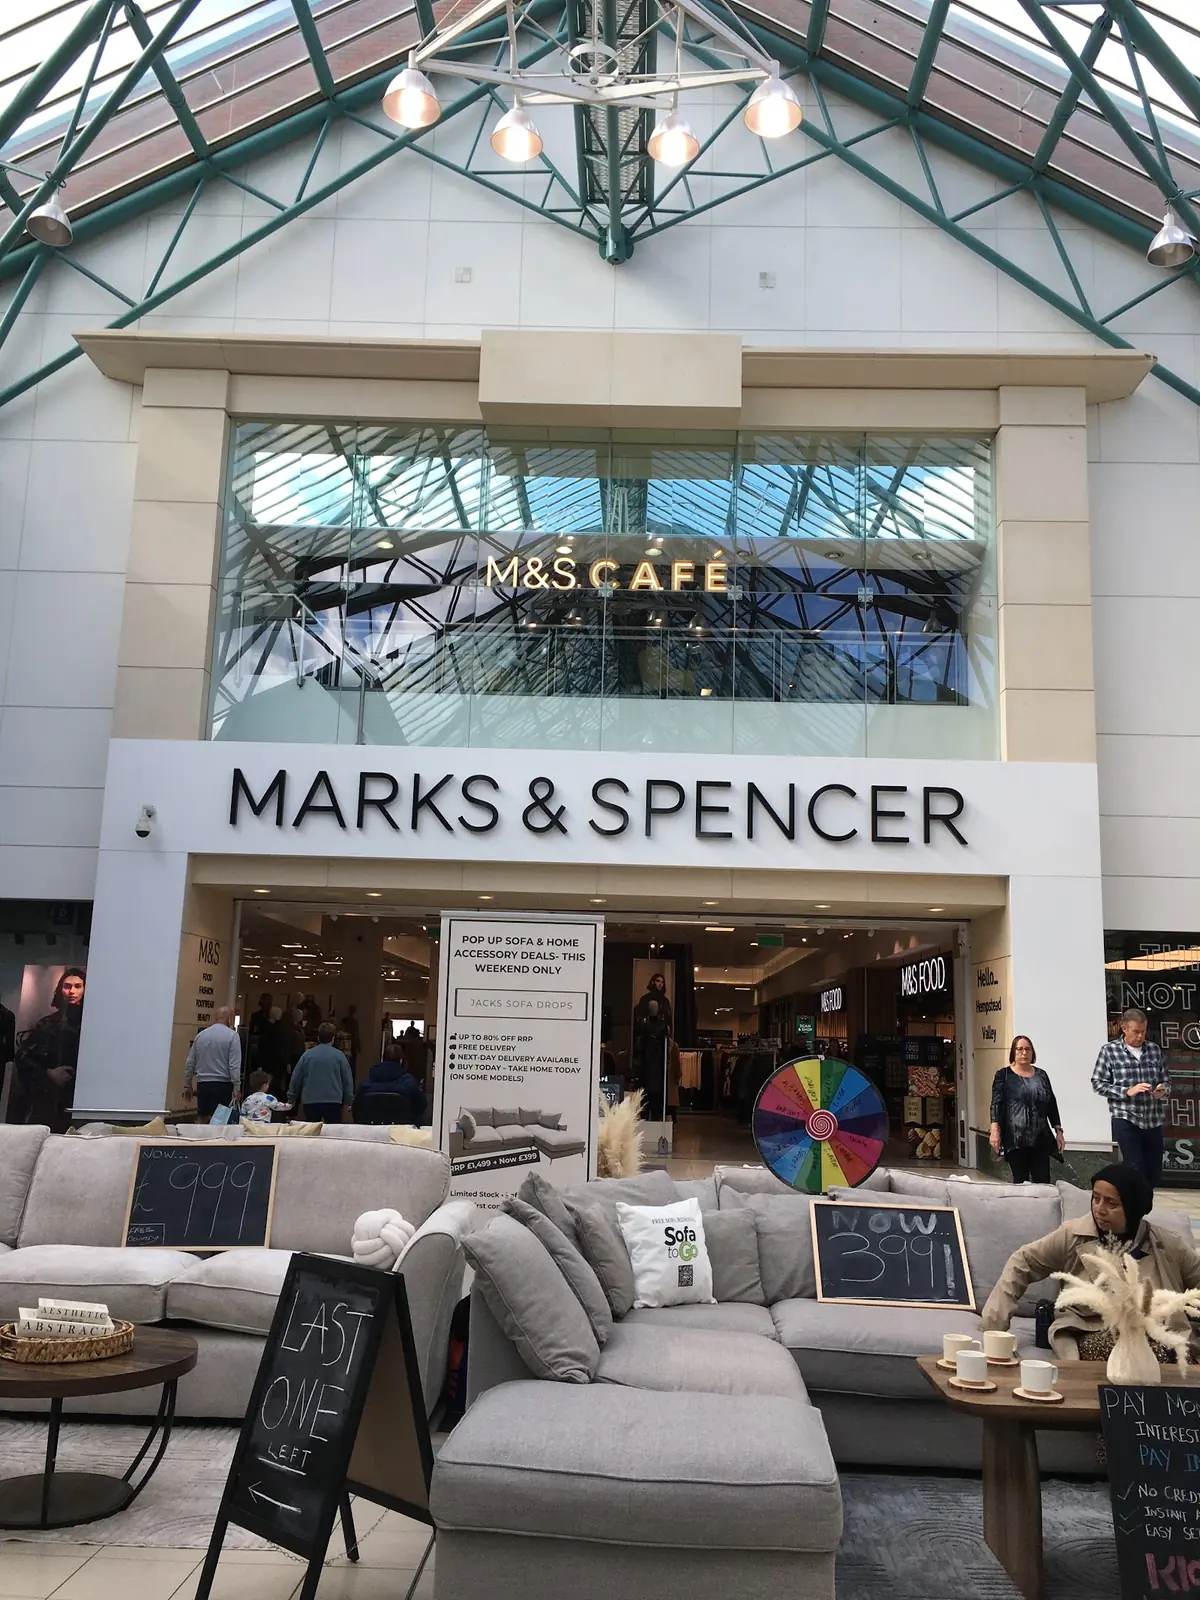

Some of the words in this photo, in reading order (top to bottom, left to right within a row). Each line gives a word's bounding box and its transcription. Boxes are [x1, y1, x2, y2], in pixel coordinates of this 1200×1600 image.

[486, 555, 577, 590] M&S
[588, 548, 728, 592] CAFÉ
[229, 768, 501, 832] MARKS
[522, 777, 568, 834] &
[588, 777, 968, 845] SPENCER
[462, 935, 485, 944] POP
[488, 936, 503, 945] UP
[505, 937, 534, 946] SOFA
[536, 938, 544, 946] &
[547, 938, 579, 947] HOME
[198, 938, 221, 966] M&S
[454, 950, 518, 959] ACCESSORY
[562, 952, 586, 961] THIS
[202, 973, 213, 982] FOOD
[475, 964, 530, 974] WEEKEND
[532, 965, 562, 975] ONLY
[901, 966, 918, 997] M&S
[919, 957, 946, 992] FOOD
[198, 985, 214, 996] FASHION
[1120, 981, 1197, 1010] NOT
[470, 998, 502, 1008] JACKS
[506, 1000, 533, 1009] SOFA
[536, 1001, 573, 1010] DROPS
[975, 997, 1002, 1015] Hempstead
[197, 1013, 211, 1022] BEAUTY
[981, 1025, 997, 1043] Valley
[458, 1043, 478, 1051] FREE
[479, 1044, 516, 1052] DELIVERY
[536, 1056, 579, 1064] AVAILABLE
[467, 1159, 491, 1170] £1,499
[499, 1157, 517, 1165] Now
[518, 1152, 538, 1162] £399
[450, 1190, 478, 1198] Limited
[129, 1226, 155, 1235] FREE
[664, 1226, 697, 1246] Sofa
[667, 1247, 679, 1258] to
[679, 1241, 698, 1261] Go
[41, 1306, 107, 1320] AESTHETIC
[22, 1321, 110, 1336] ABSTRACT
[280, 1289, 375, 1375] LAST
[261, 1375, 345, 1442] ONE
[1103, 1387, 1146, 1418] PAY
[1134, 1421, 1200, 1443] INTEREST
[267, 1441, 312, 1468] LEFT
[1139, 1444, 1171, 1472] PAY
[1144, 1505, 1187, 1523] INSTANT
[1145, 1523, 1172, 1541] EASY
